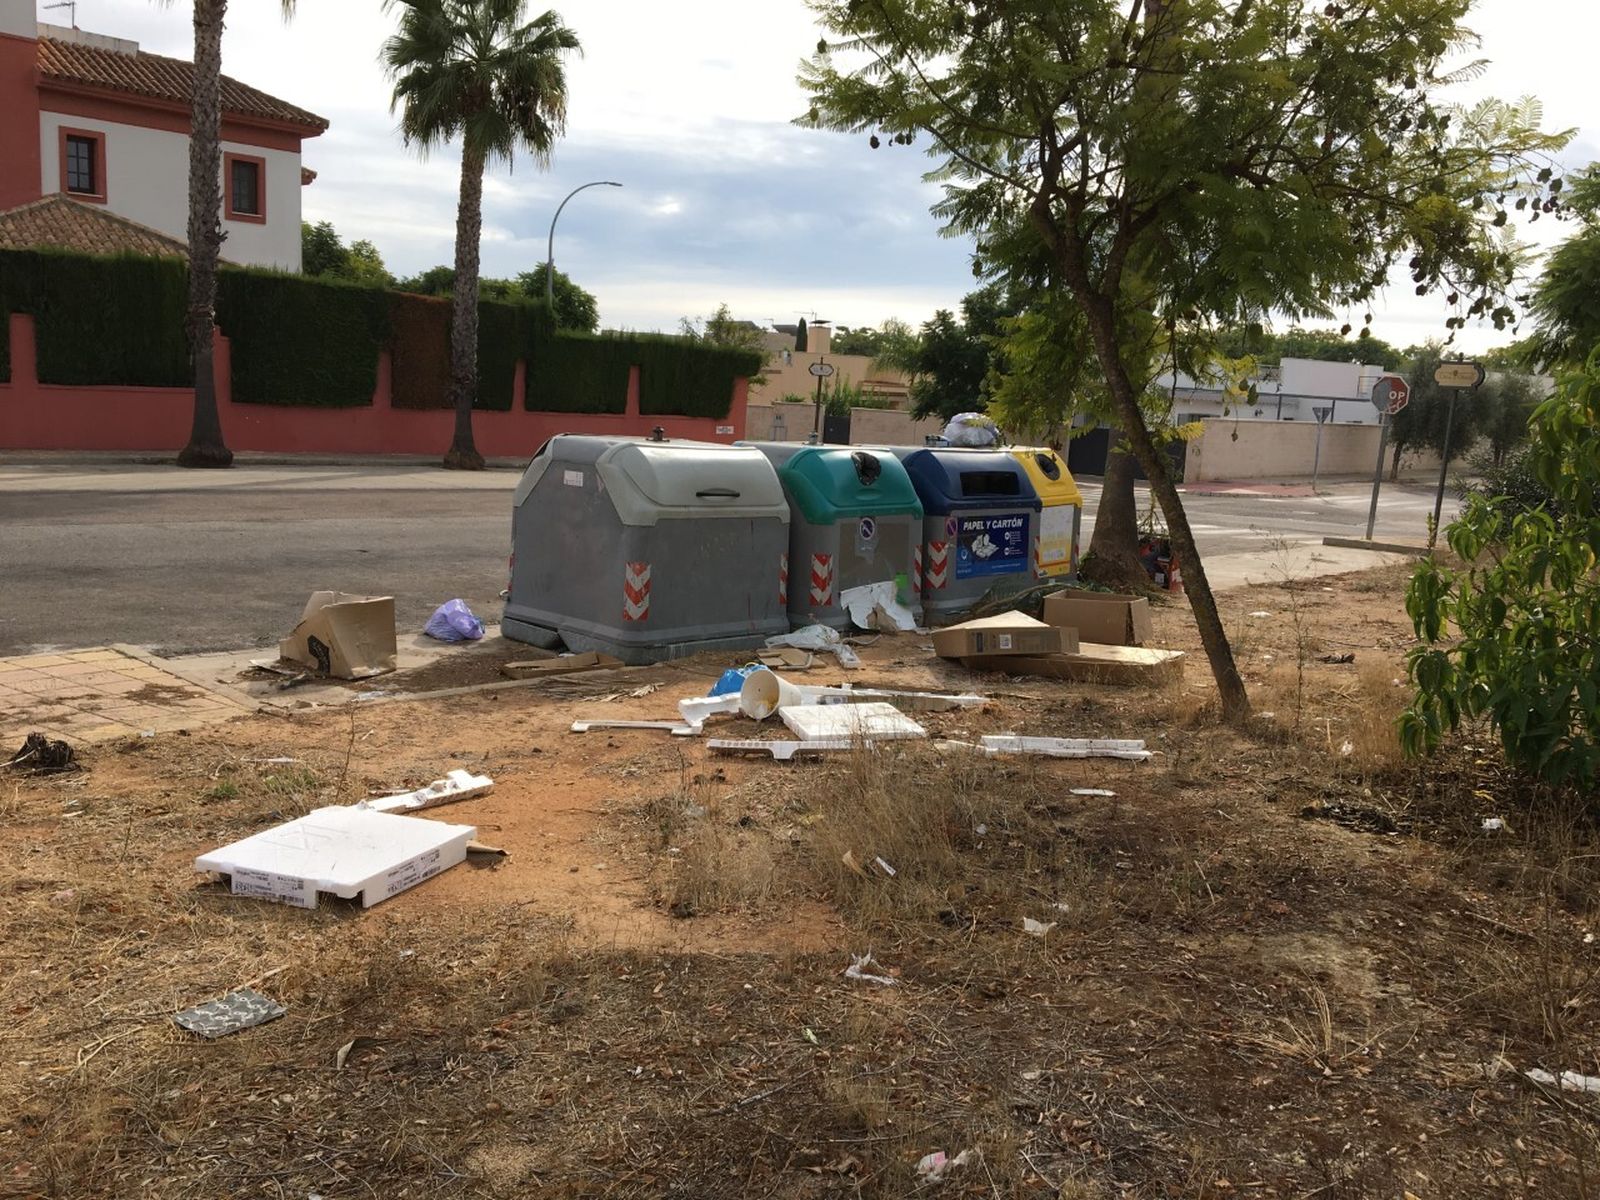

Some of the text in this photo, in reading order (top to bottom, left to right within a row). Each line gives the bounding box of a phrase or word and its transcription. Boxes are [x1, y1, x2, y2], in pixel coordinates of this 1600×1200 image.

[1389, 390, 1406, 400] OP
[963, 518, 1024, 530] PAPEL Y CARTÓN
